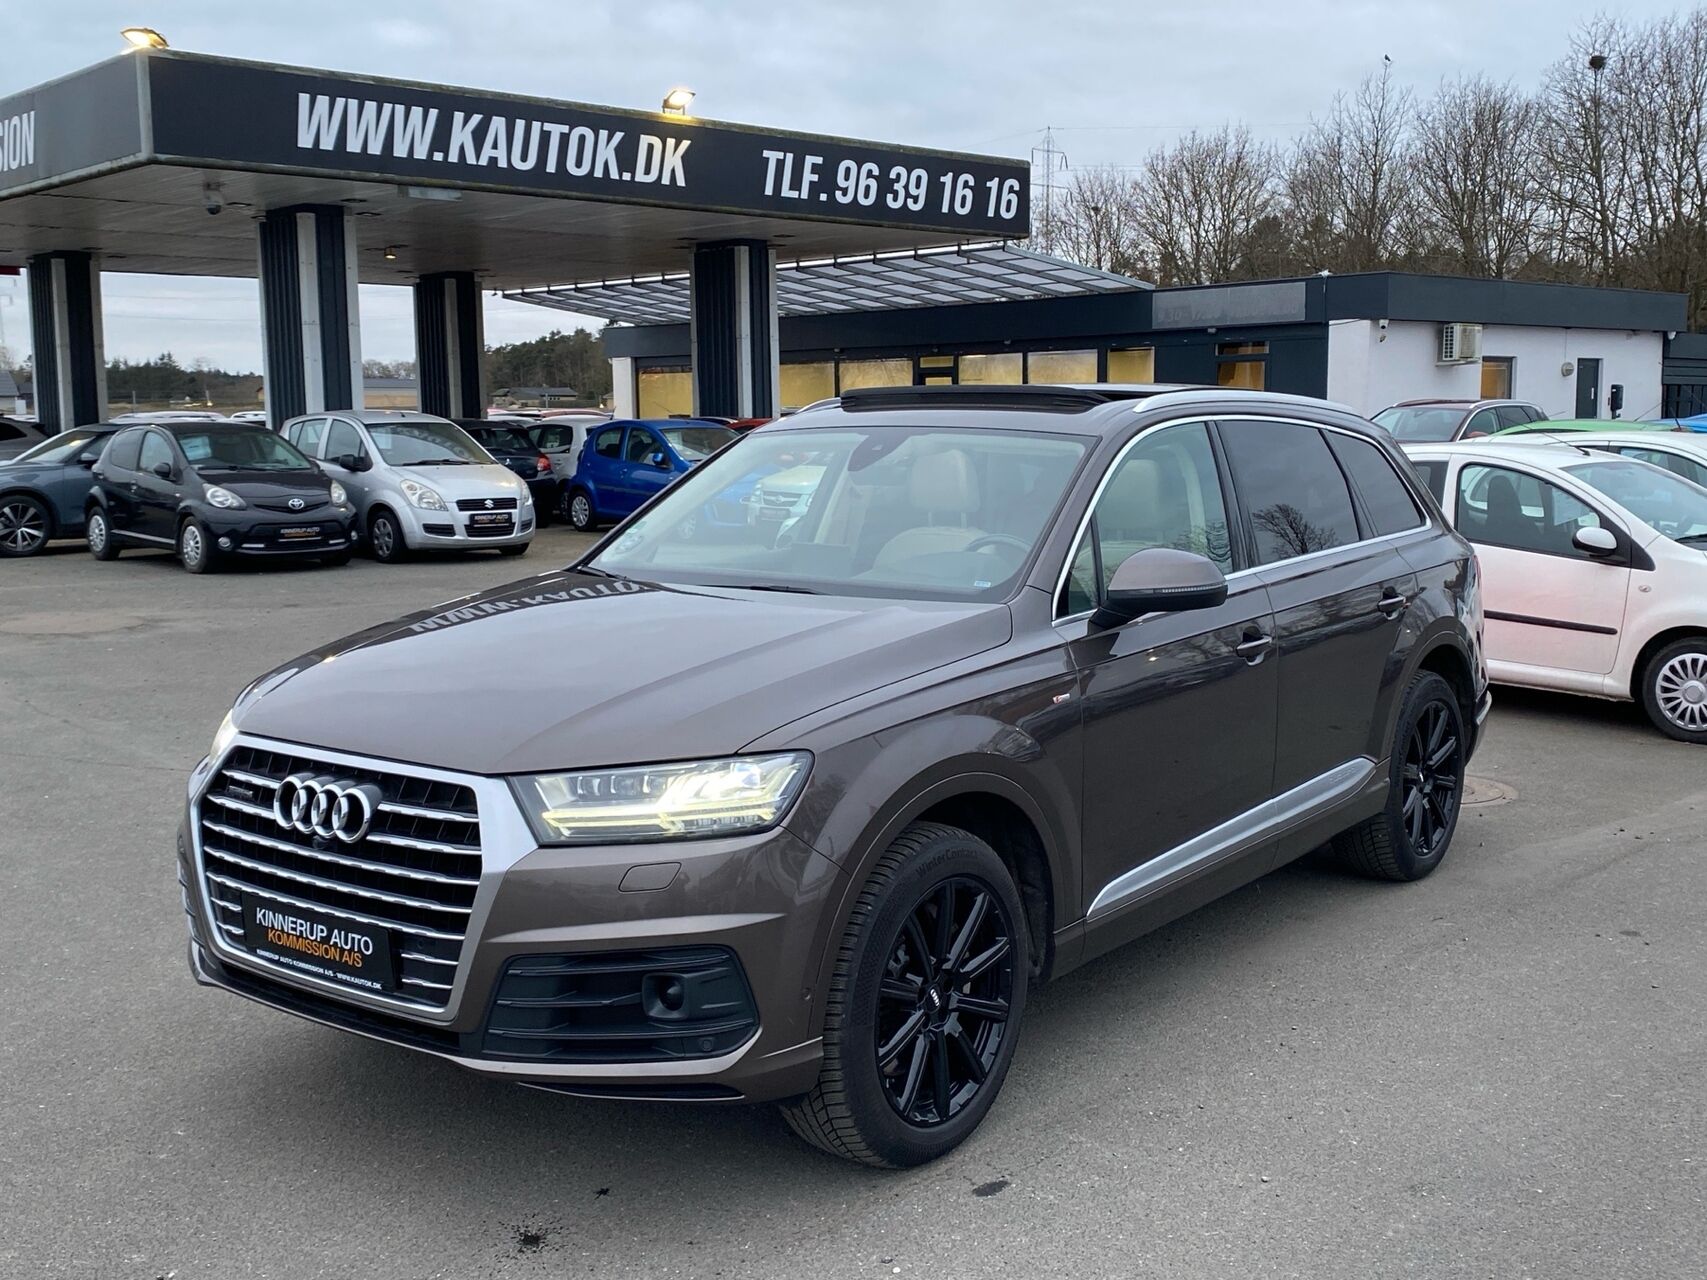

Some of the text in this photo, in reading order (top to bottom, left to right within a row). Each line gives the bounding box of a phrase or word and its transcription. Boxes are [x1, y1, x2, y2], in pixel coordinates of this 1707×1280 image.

[297, 92, 692, 188] WWW.KAUTOK.DK
[762, 149, 1021, 221] TLF. 96 39 16 16
[256, 907, 373, 955] KINNERUP AUTO
[267, 928, 363, 968] KOMMISSION A/S
